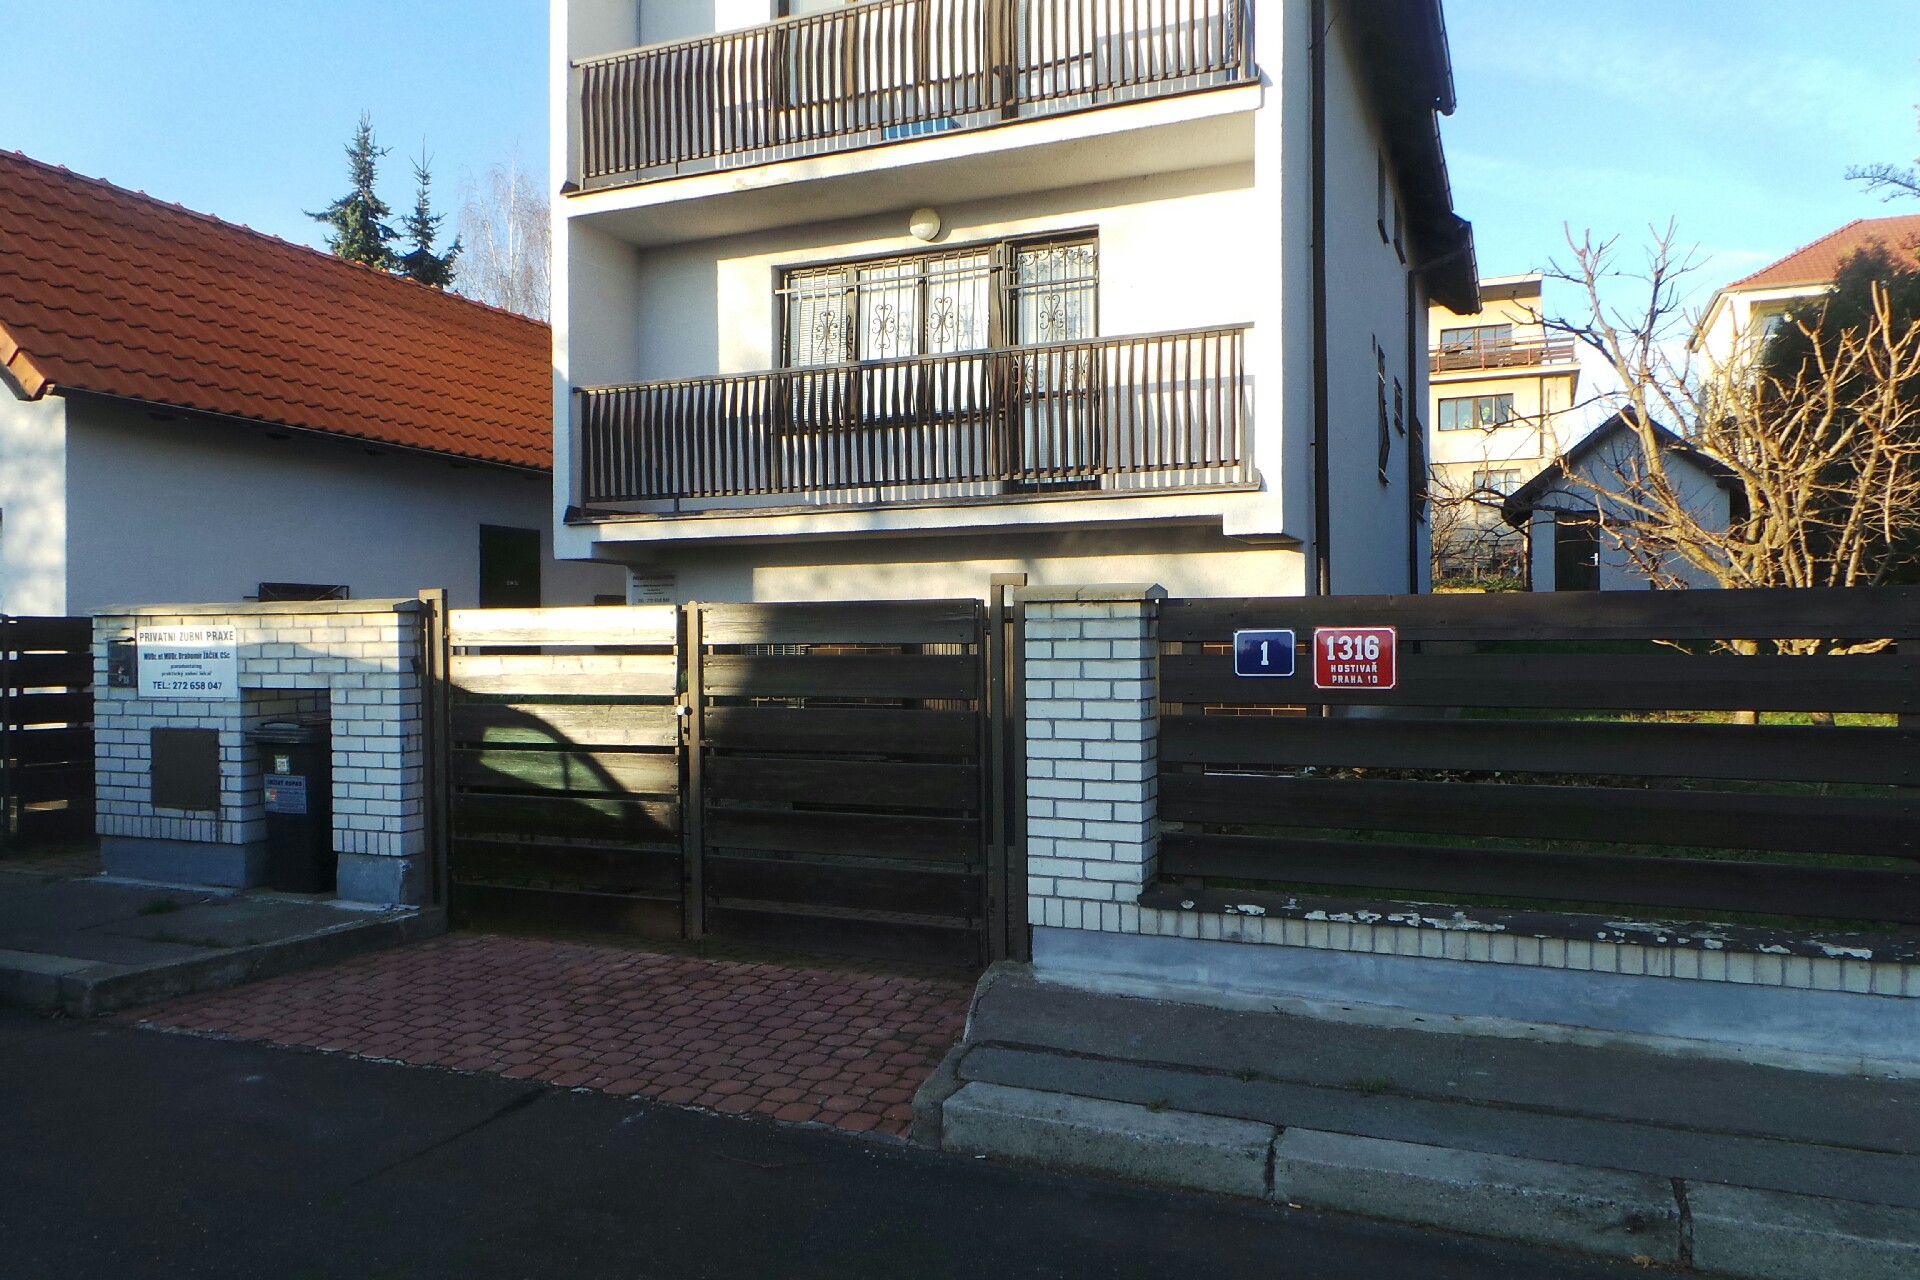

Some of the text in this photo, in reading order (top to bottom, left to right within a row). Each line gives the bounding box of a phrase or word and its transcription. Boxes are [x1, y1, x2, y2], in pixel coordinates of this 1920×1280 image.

[206, 630, 234, 641] PRAXE
[1260, 640, 1269, 666] 1
[1326, 635, 1380, 661] 1316
[1330, 662, 1378, 673] HOSTIVAŘ
[1331, 675, 1378, 684] PRAHA 10
[172, 681, 188, 690] 272
[189, 681, 206, 690] 658
[207, 681, 222, 690] 047
